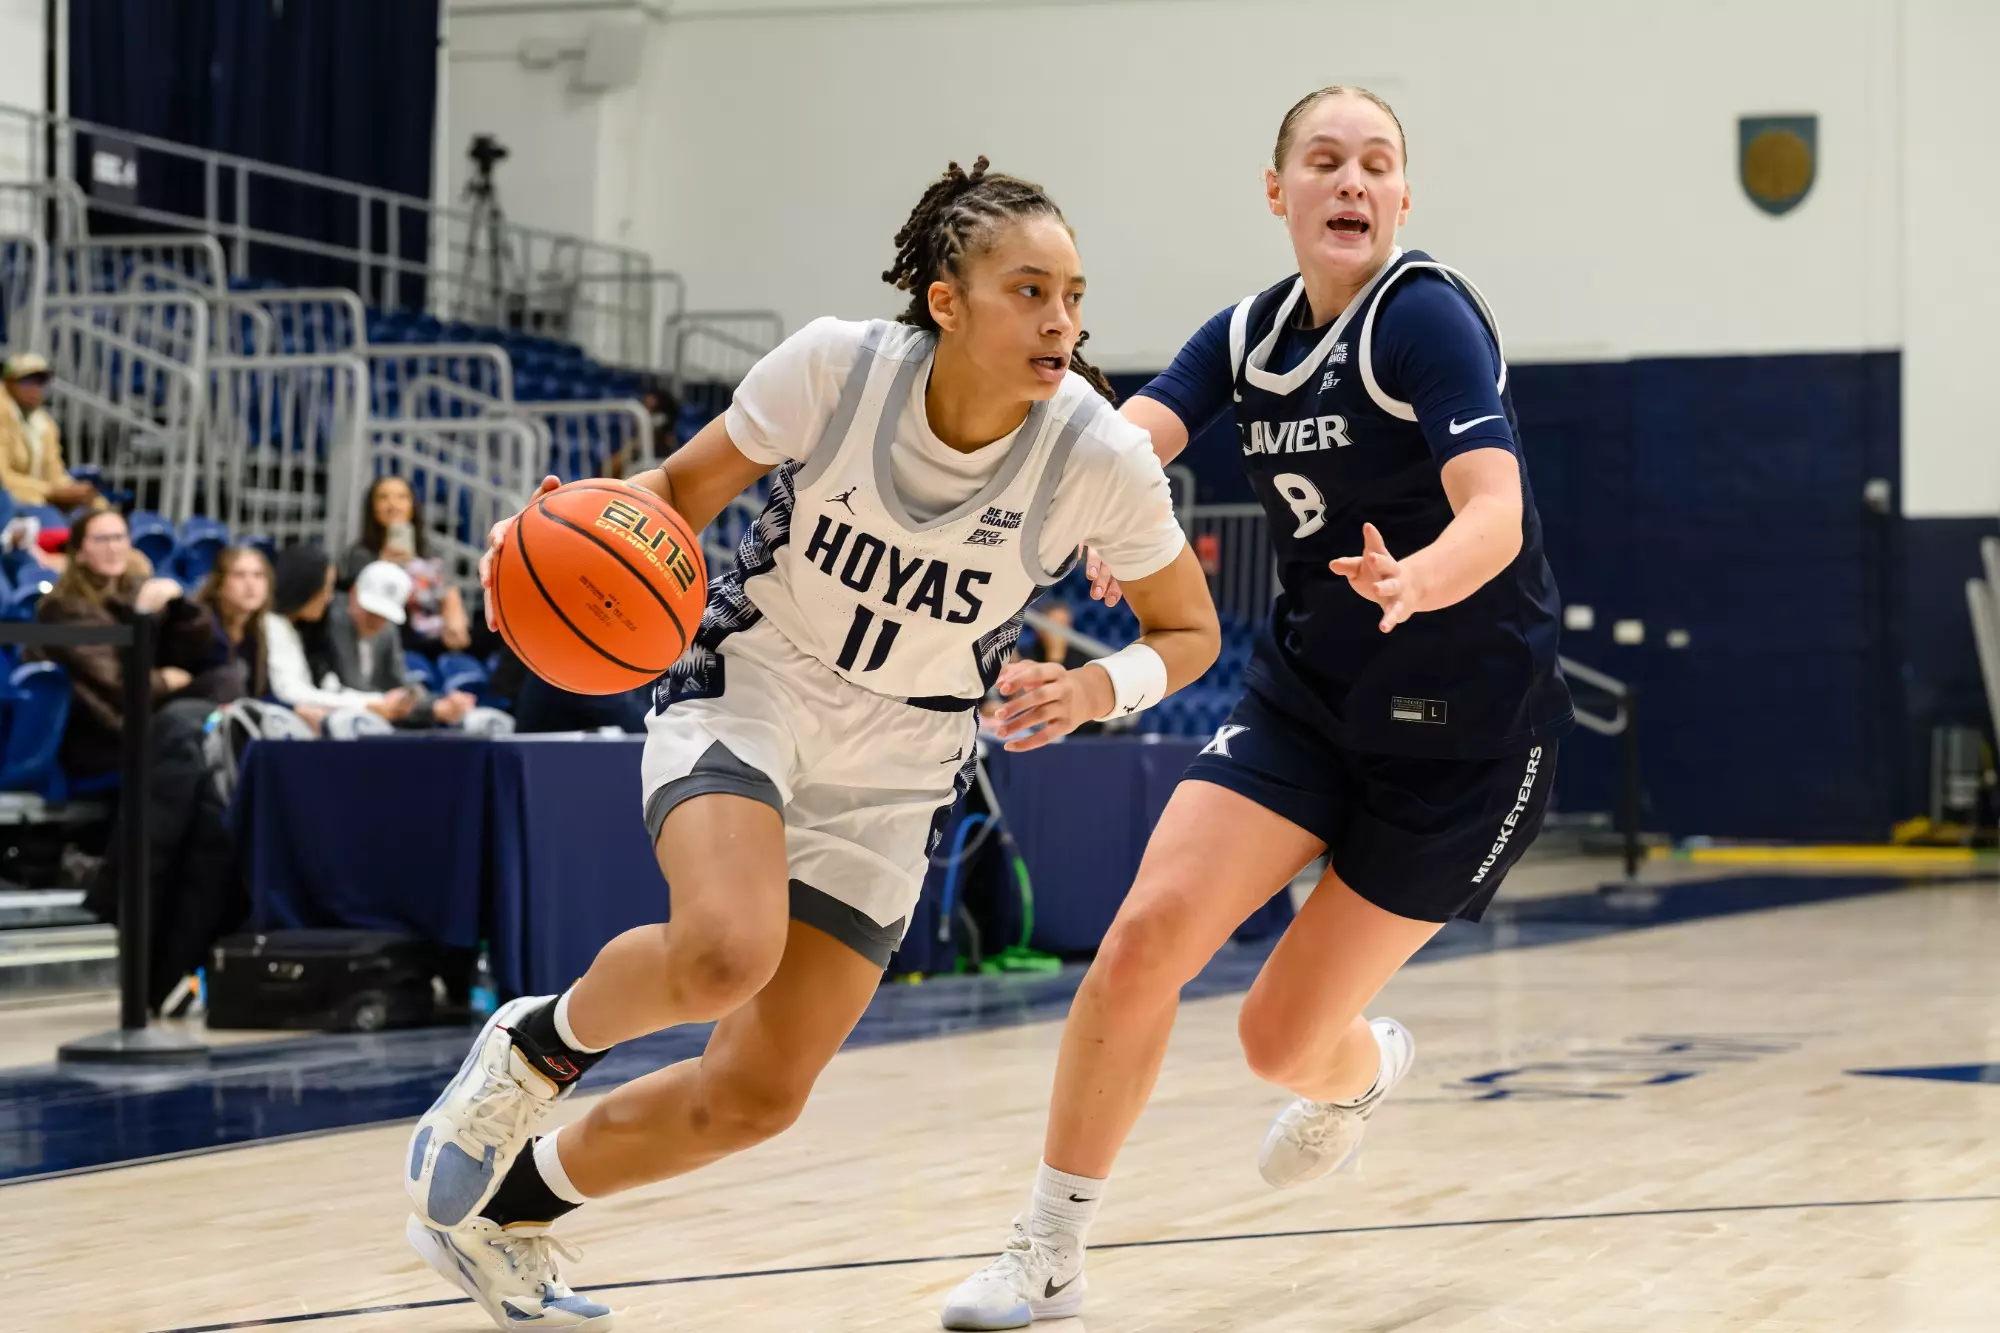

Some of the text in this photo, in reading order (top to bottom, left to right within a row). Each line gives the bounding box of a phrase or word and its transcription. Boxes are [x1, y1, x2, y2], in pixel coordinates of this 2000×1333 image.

[1320, 379, 1342, 389] AST
[1273, 473, 1328, 538] 8
[986, 506, 1025, 521] BE THE
[980, 514, 1022, 529] CHANGE
[966, 535, 1008, 546] EAST
[972, 528, 1002, 538] BIG
[601, 499, 697, 593] ELITE
[804, 514, 993, 625] HOYAS
[835, 603, 902, 672] 11
[1431, 706, 1438, 717] L
[1471, 745, 1543, 884] MUSKETEERS
